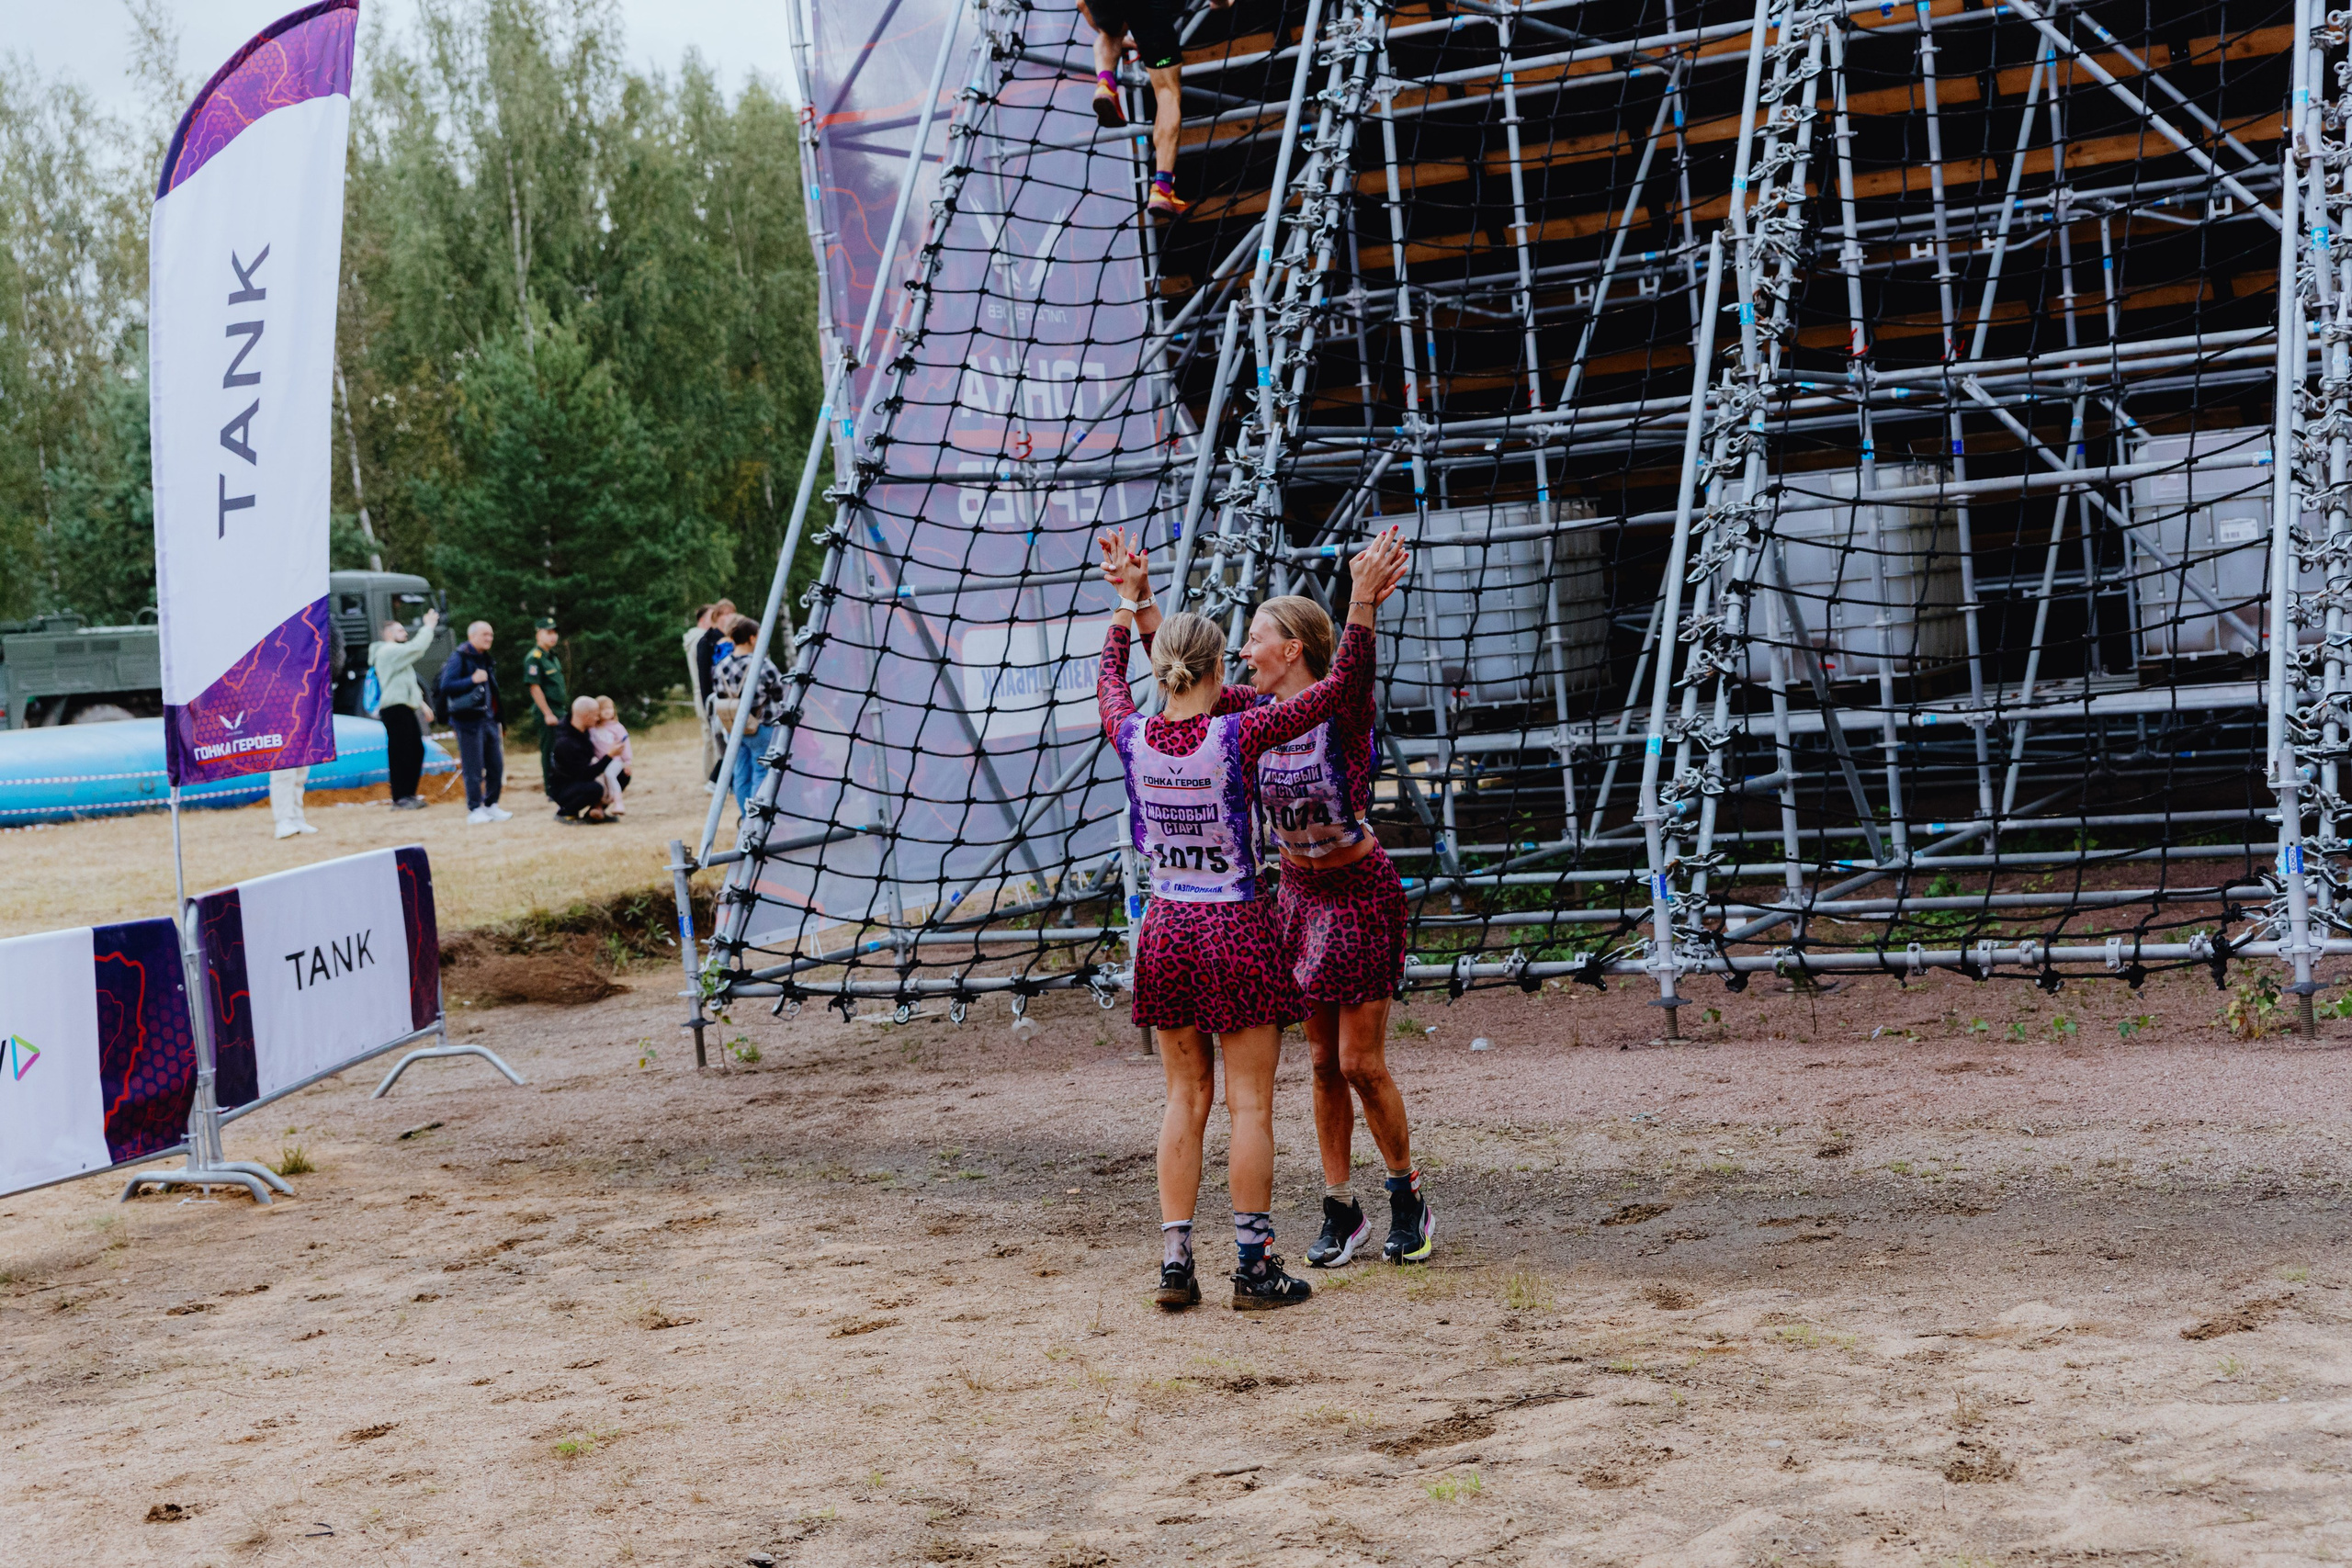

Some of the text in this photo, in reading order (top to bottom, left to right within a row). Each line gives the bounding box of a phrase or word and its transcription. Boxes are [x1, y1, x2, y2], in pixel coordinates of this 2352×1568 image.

[219, 243, 270, 540] TANK
[194, 733, 283, 761] ГОНКА ГЕРОЕВ
[1143, 775, 1212, 787] ГОНКА ГЕРОЕВ
[1148, 803, 1216, 821] МАССОВЫЙ
[1266, 803, 1333, 831] 1074
[1164, 822, 1199, 835] СТАРТ
[1153, 843, 1229, 874] 1075
[1173, 883, 1224, 894] ГАЗПРОМБАНК
[285, 929, 375, 991] TANK
